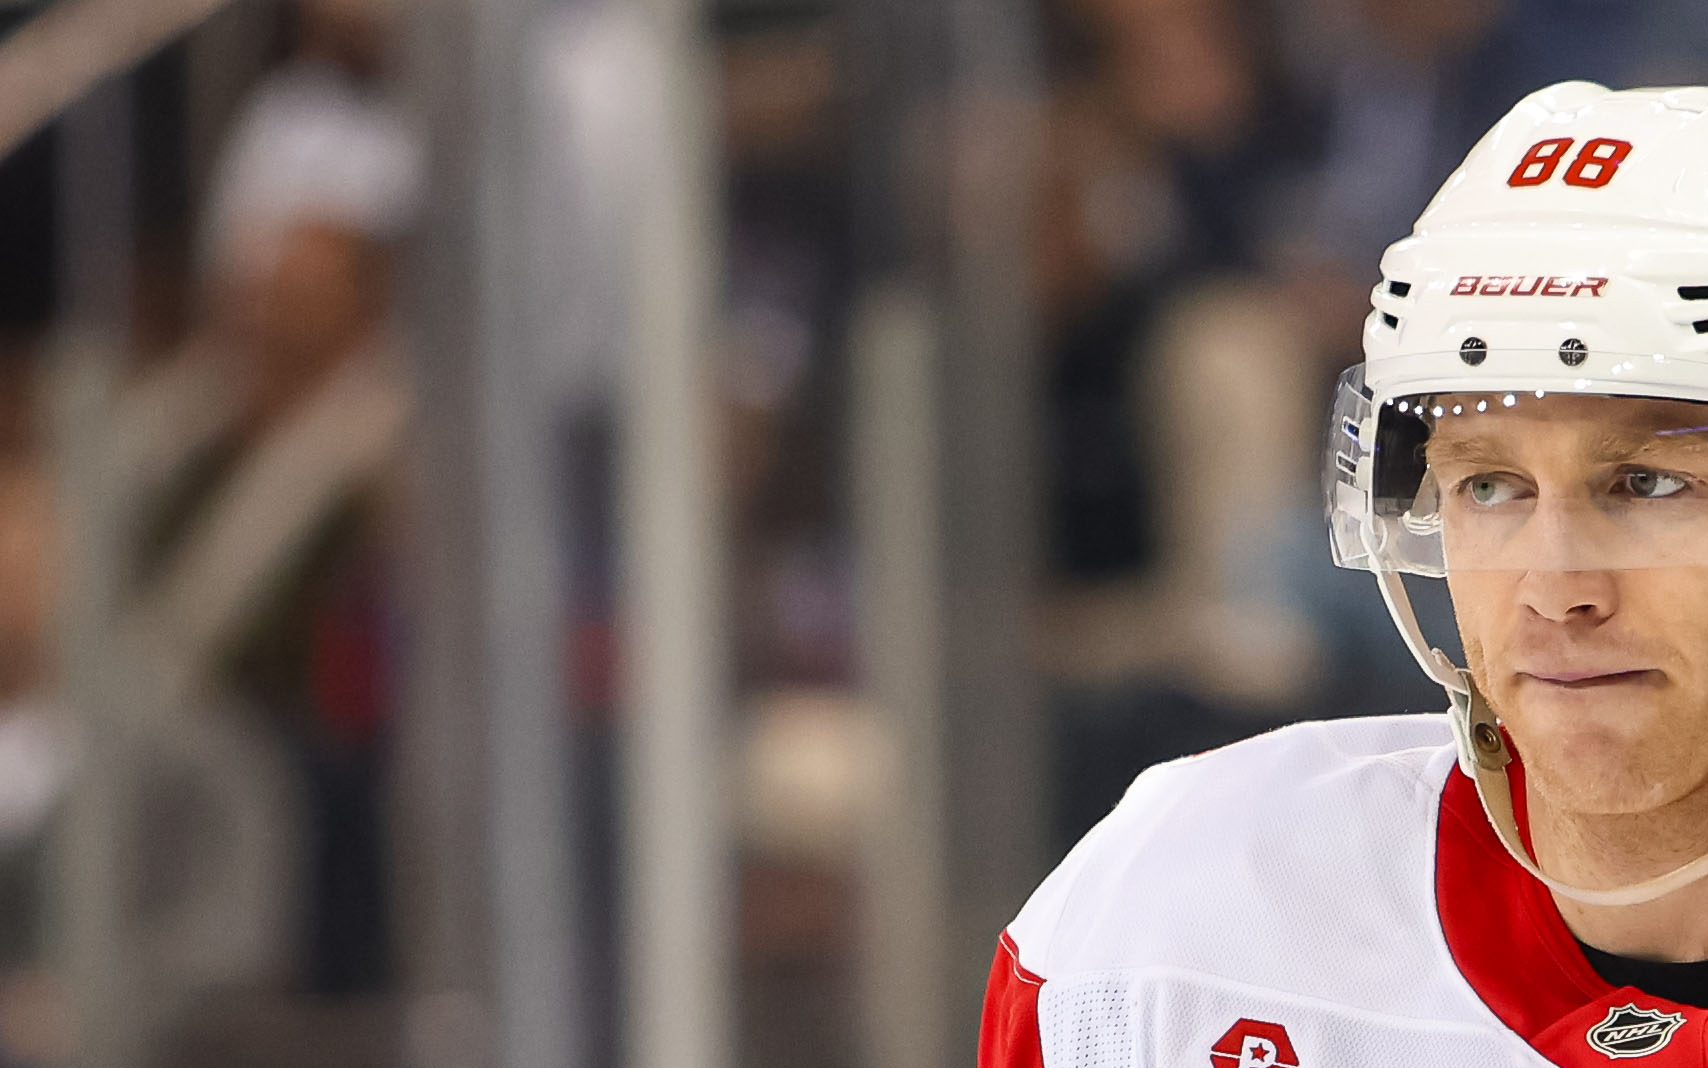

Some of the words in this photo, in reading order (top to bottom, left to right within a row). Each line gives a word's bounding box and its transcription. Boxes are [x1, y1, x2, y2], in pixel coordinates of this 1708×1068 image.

[1507, 137, 1633, 188] 88
[1450, 275, 1608, 297] BAUER
[1603, 1024, 1664, 1042] NHL
